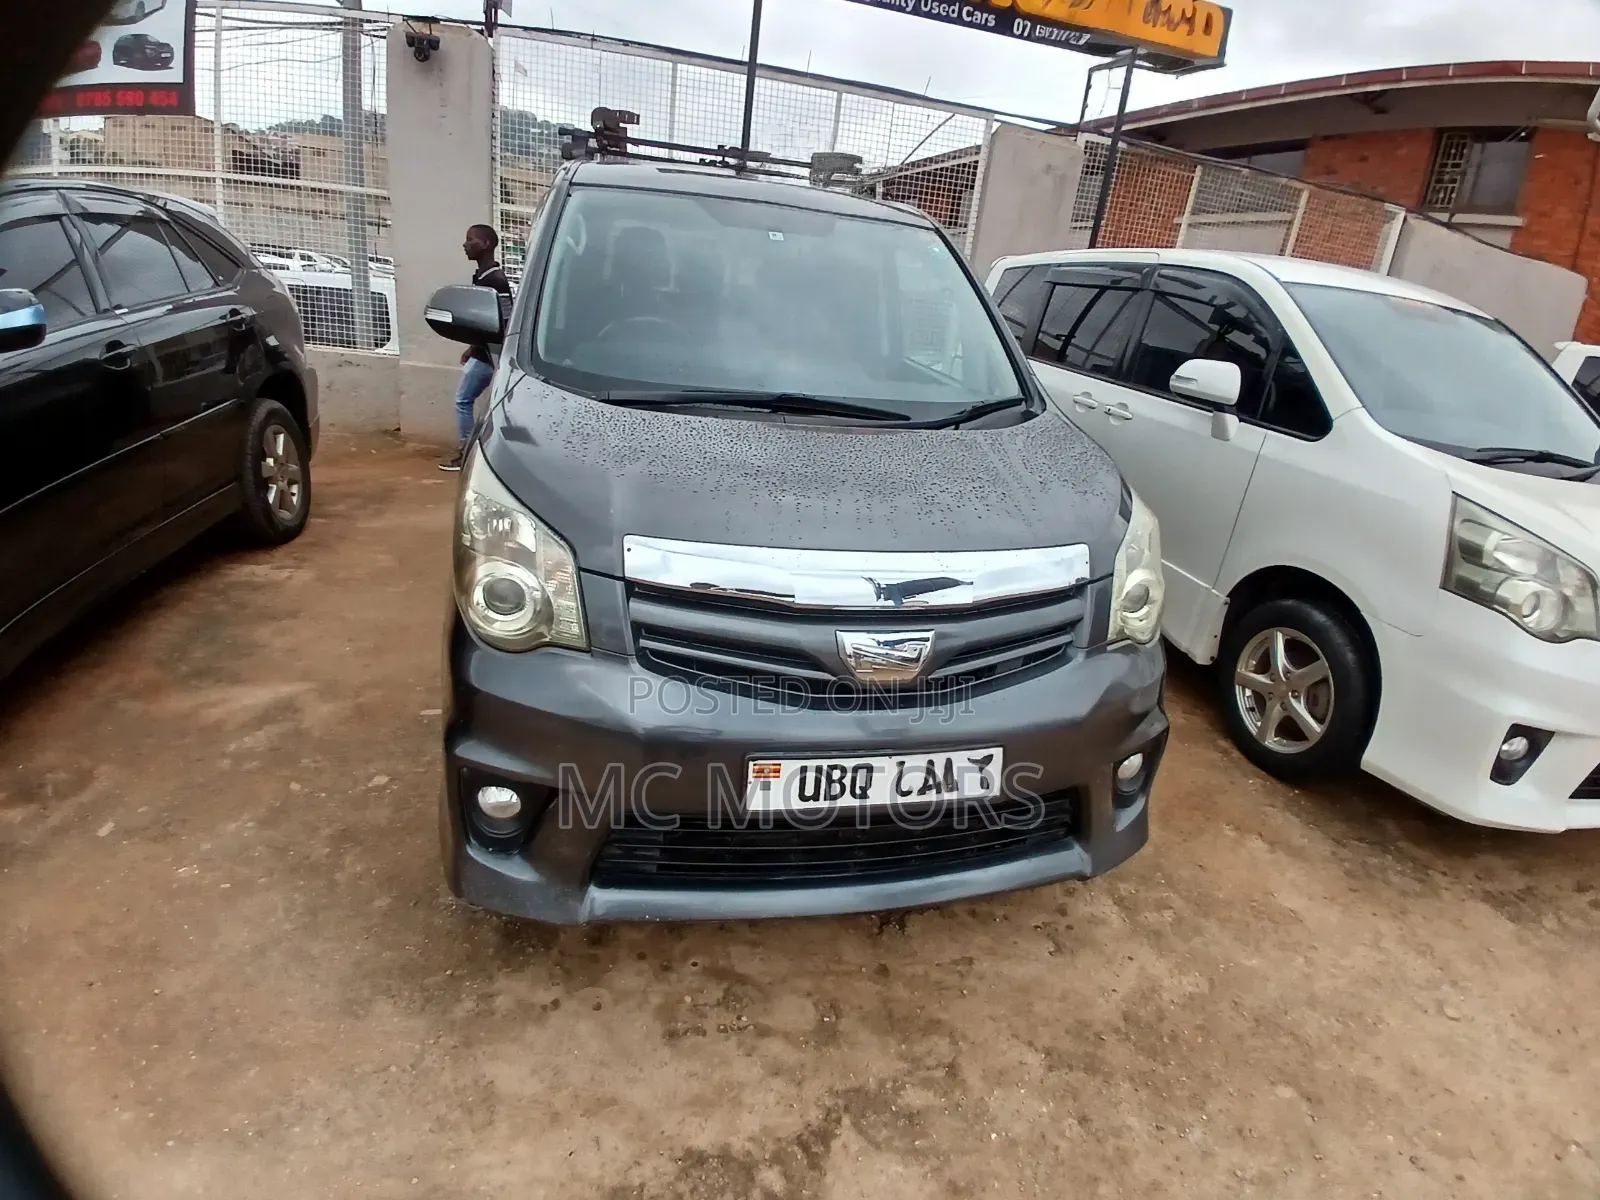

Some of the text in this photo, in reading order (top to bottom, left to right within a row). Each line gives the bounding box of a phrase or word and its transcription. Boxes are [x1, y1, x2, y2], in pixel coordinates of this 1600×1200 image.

[920, 0, 960, 18] Used
[961, 6, 996, 27] Cars
[797, 762, 875, 803] UBQ
